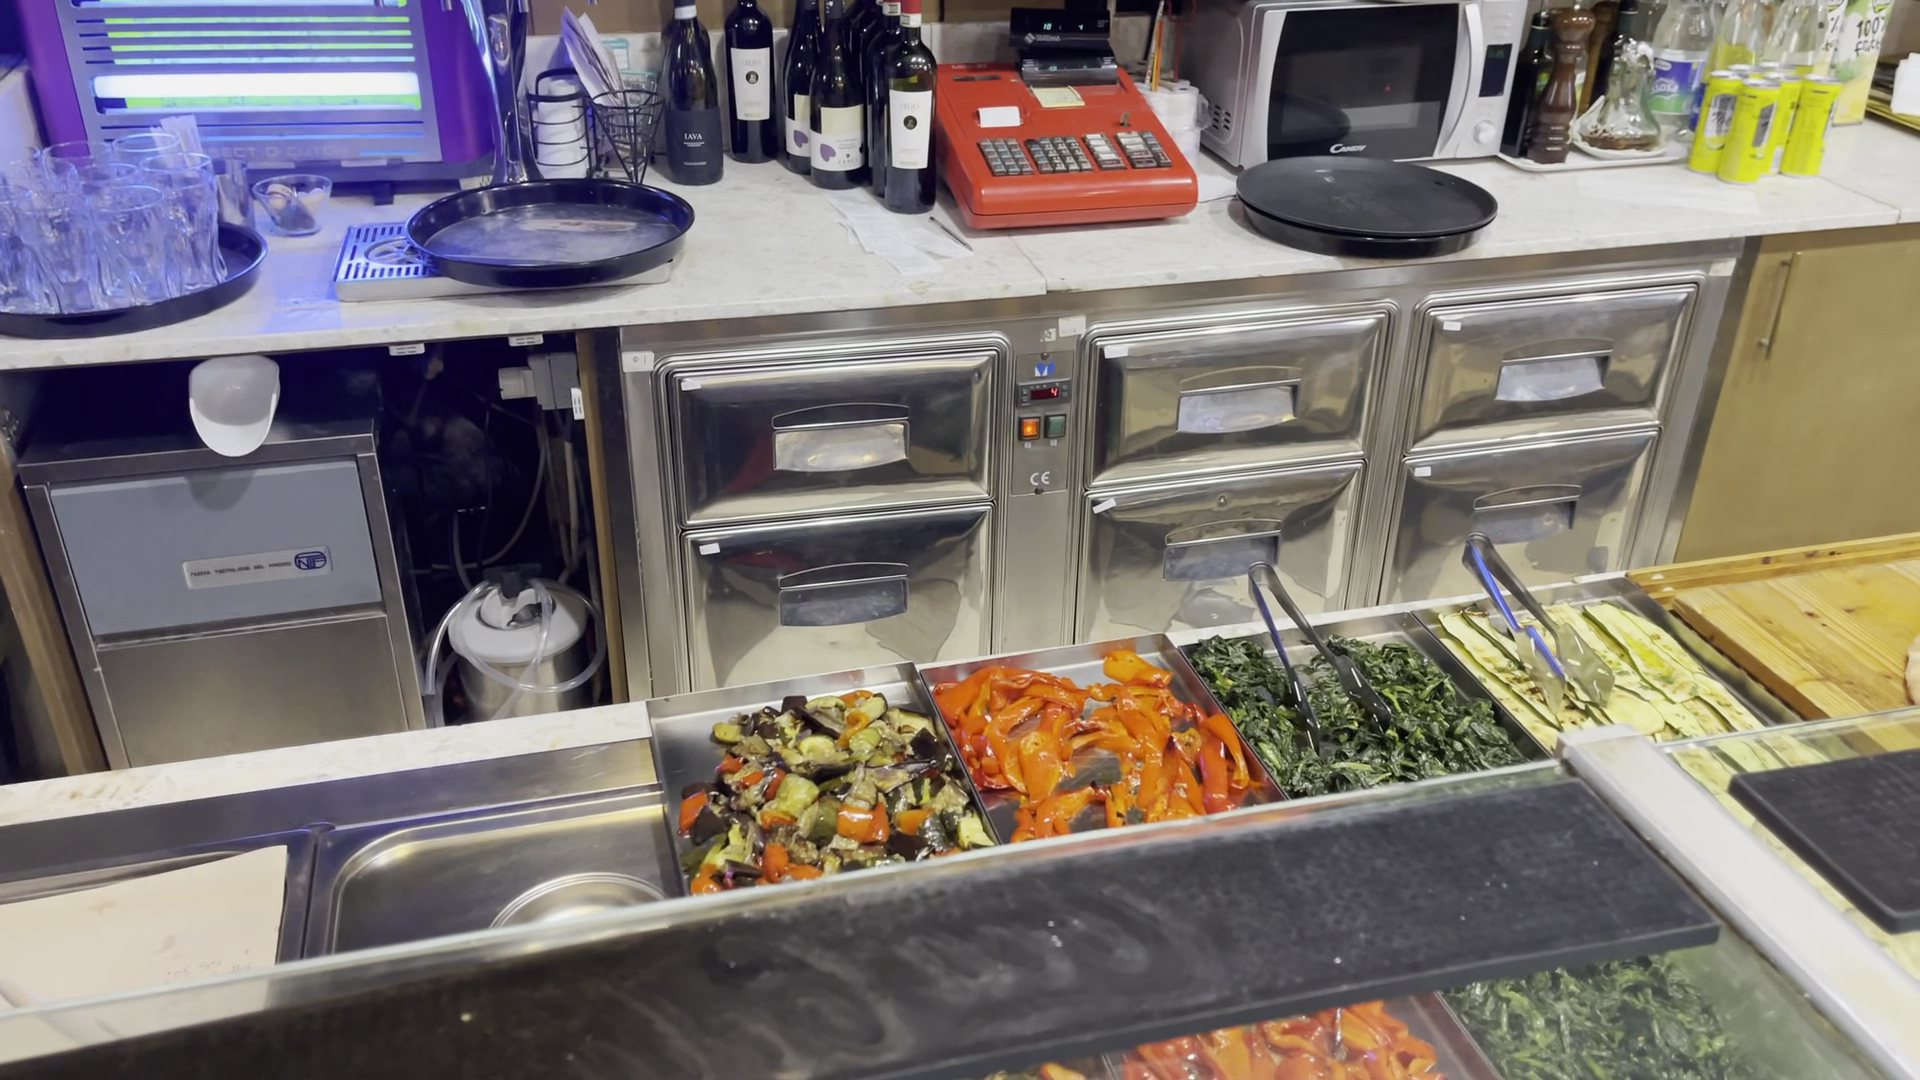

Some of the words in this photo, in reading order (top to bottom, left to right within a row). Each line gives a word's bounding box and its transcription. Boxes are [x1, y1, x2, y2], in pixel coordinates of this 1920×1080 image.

[1329, 143, 1367, 154] CANDY
[1051, 387, 1058, 397] 4
[1029, 471, 1050, 486] CE
